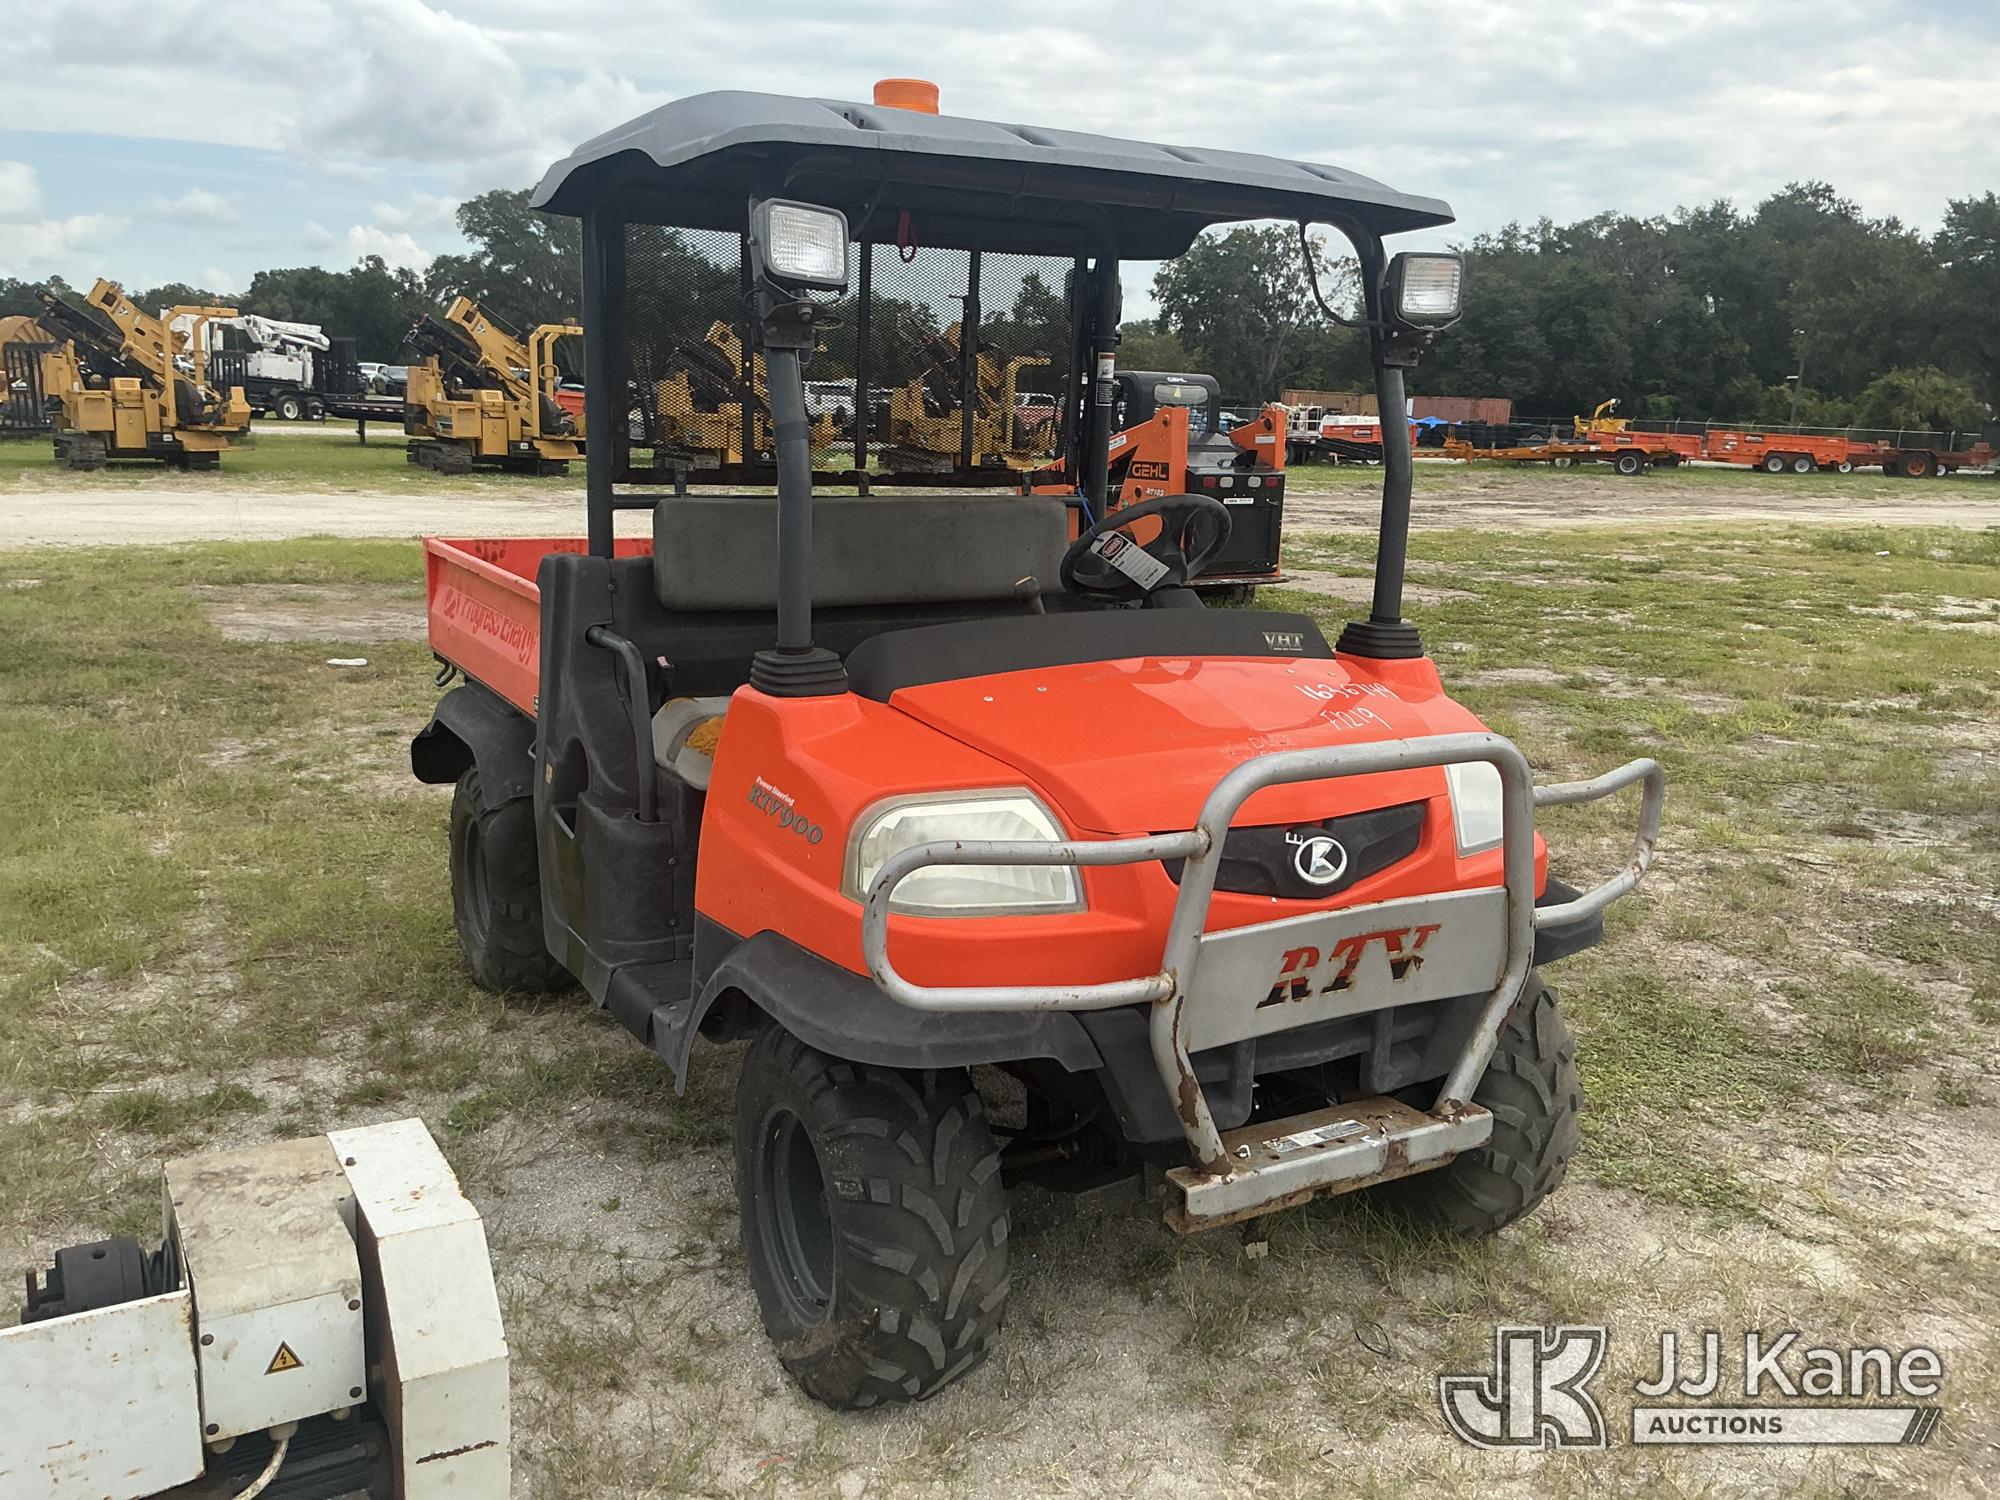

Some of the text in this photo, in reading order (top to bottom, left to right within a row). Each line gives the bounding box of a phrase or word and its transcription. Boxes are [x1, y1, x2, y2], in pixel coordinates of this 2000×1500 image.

[1132, 463, 1167, 478] GEHL
[1262, 631, 1304, 649] VHT
[747, 784, 823, 844] RTV900
[1256, 923, 1442, 1009] RTV
